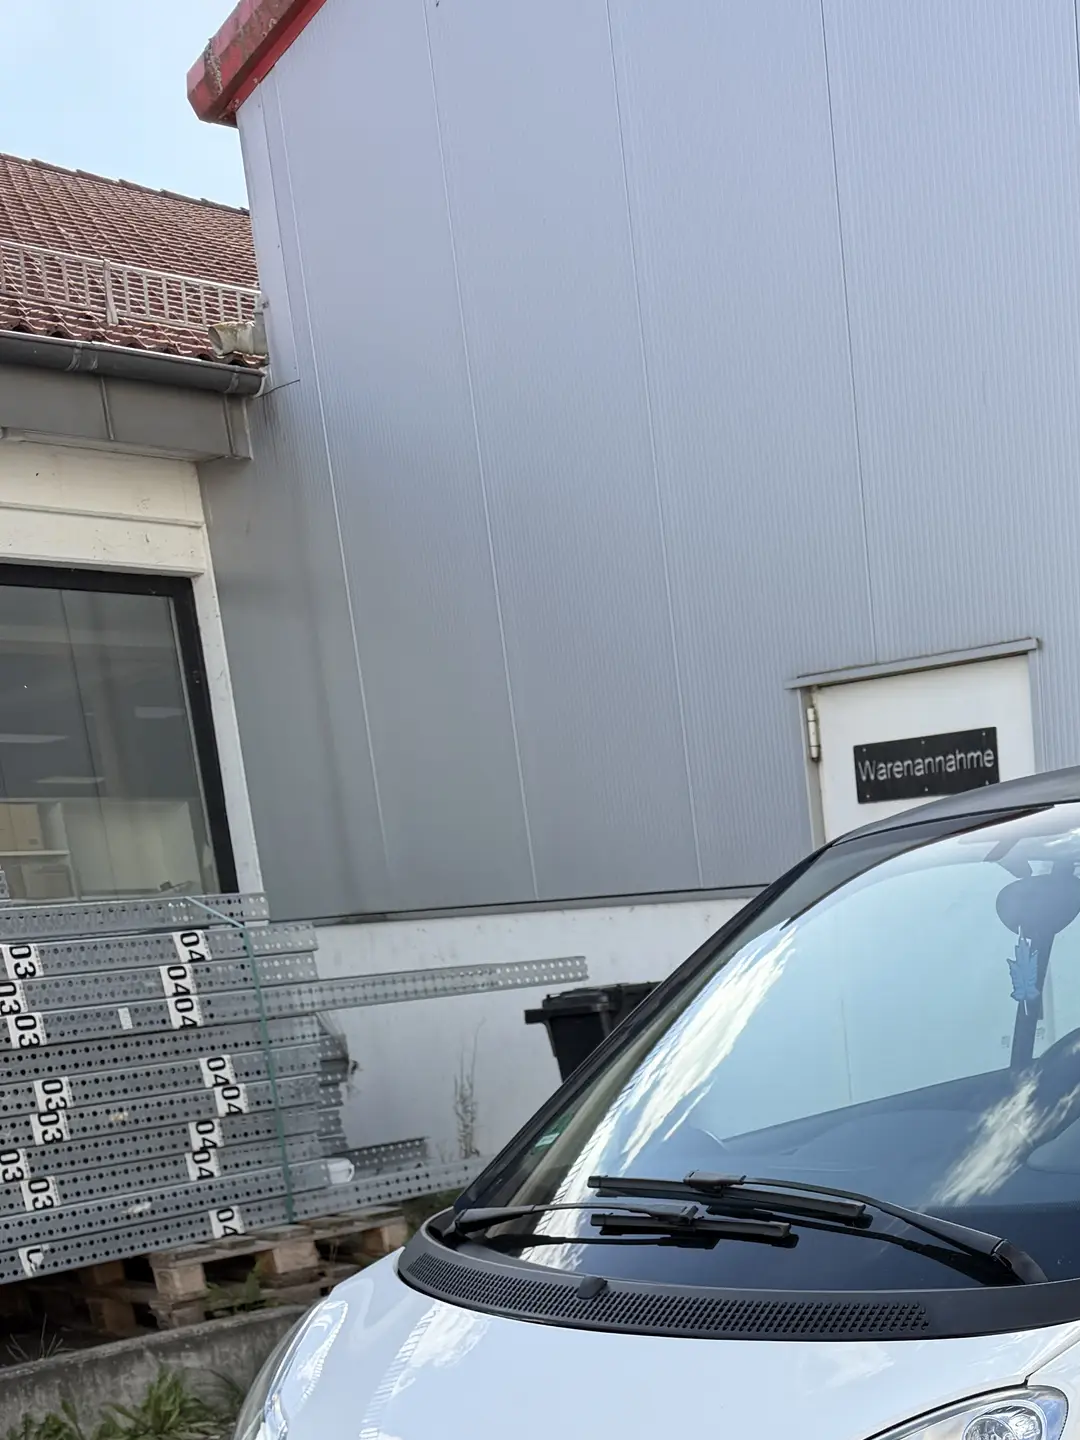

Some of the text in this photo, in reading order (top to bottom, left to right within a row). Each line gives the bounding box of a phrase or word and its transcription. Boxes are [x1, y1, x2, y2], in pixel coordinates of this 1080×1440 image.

[858, 749, 995, 781] Warenannahme
[9, 945, 38, 979] 03
[0, 981, 21, 1016] 03
[14, 1015, 41, 1048] 03
[41, 1079, 68, 1111] 03
[37, 1112, 64, 1145] 03
[0, 1150, 25, 1182] 03
[27, 1178, 54, 1211] 03
